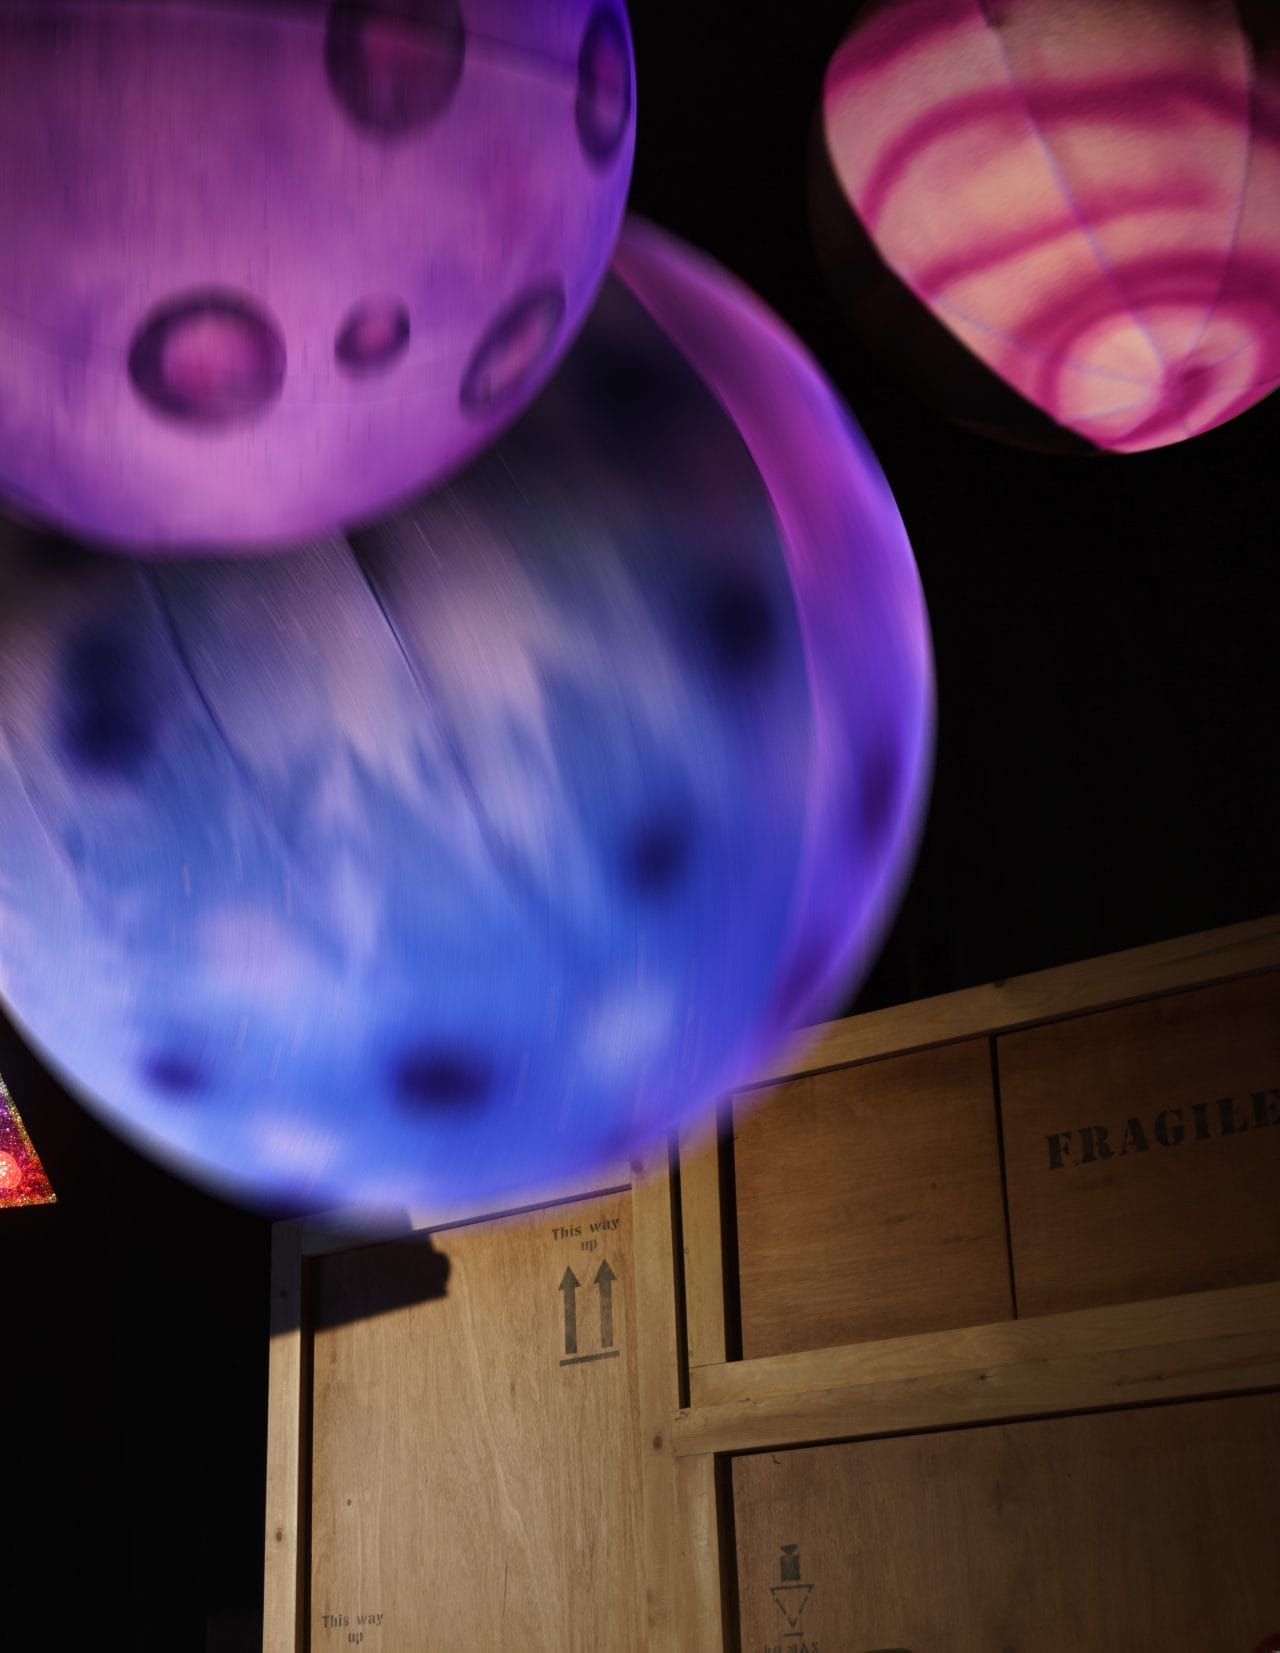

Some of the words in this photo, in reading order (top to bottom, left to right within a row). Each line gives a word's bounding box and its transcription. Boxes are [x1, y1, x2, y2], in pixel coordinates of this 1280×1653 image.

[1045, 1088, 1280, 1170] FRAGILE
[552, 1224, 582, 1241] This
[588, 1217, 620, 1232] way
[581, 1239, 598, 1252] up
[322, 1614, 350, 1628] This
[357, 1613, 384, 1626] way
[348, 1632, 363, 1645] up
